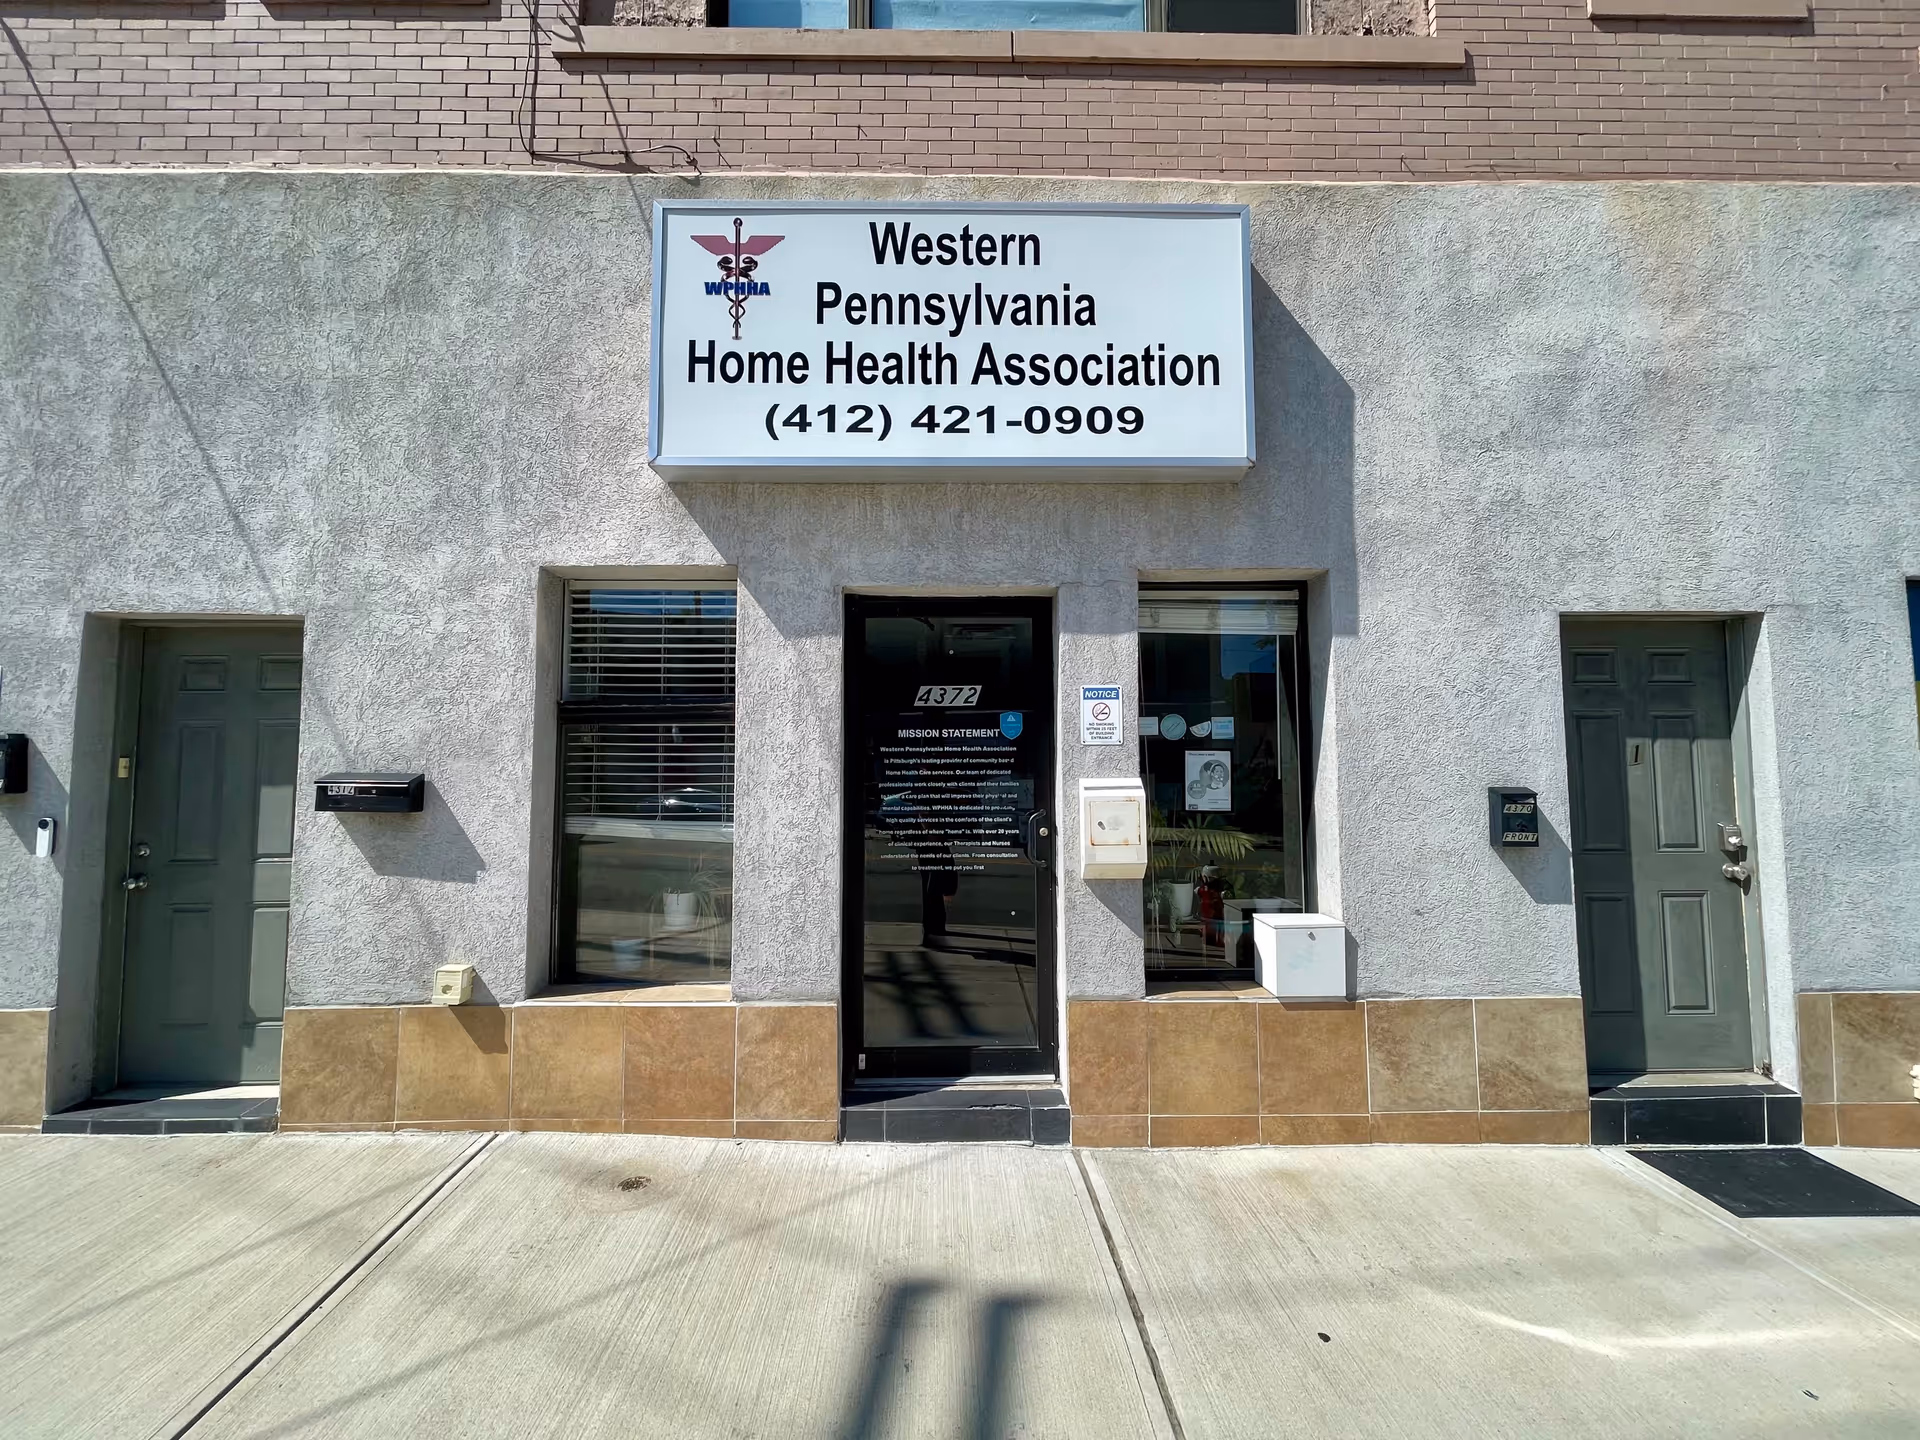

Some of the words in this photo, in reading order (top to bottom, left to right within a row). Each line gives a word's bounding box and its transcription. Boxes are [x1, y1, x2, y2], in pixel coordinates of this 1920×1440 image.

[869, 222, 1042, 266] Western
[704, 282, 771, 296] WPHHA
[815, 282, 1098, 338] Pennsylvania
[687, 340, 810, 385] Home
[825, 341, 958, 386] Health
[971, 342, 1221, 386] Association
[765, 404, 892, 440] (412)
[911, 405, 1145, 434] 421-0909
[918, 686, 978, 704] 4372
[898, 729, 940, 738] MISSION
[942, 729, 1000, 738] STATEMENT
